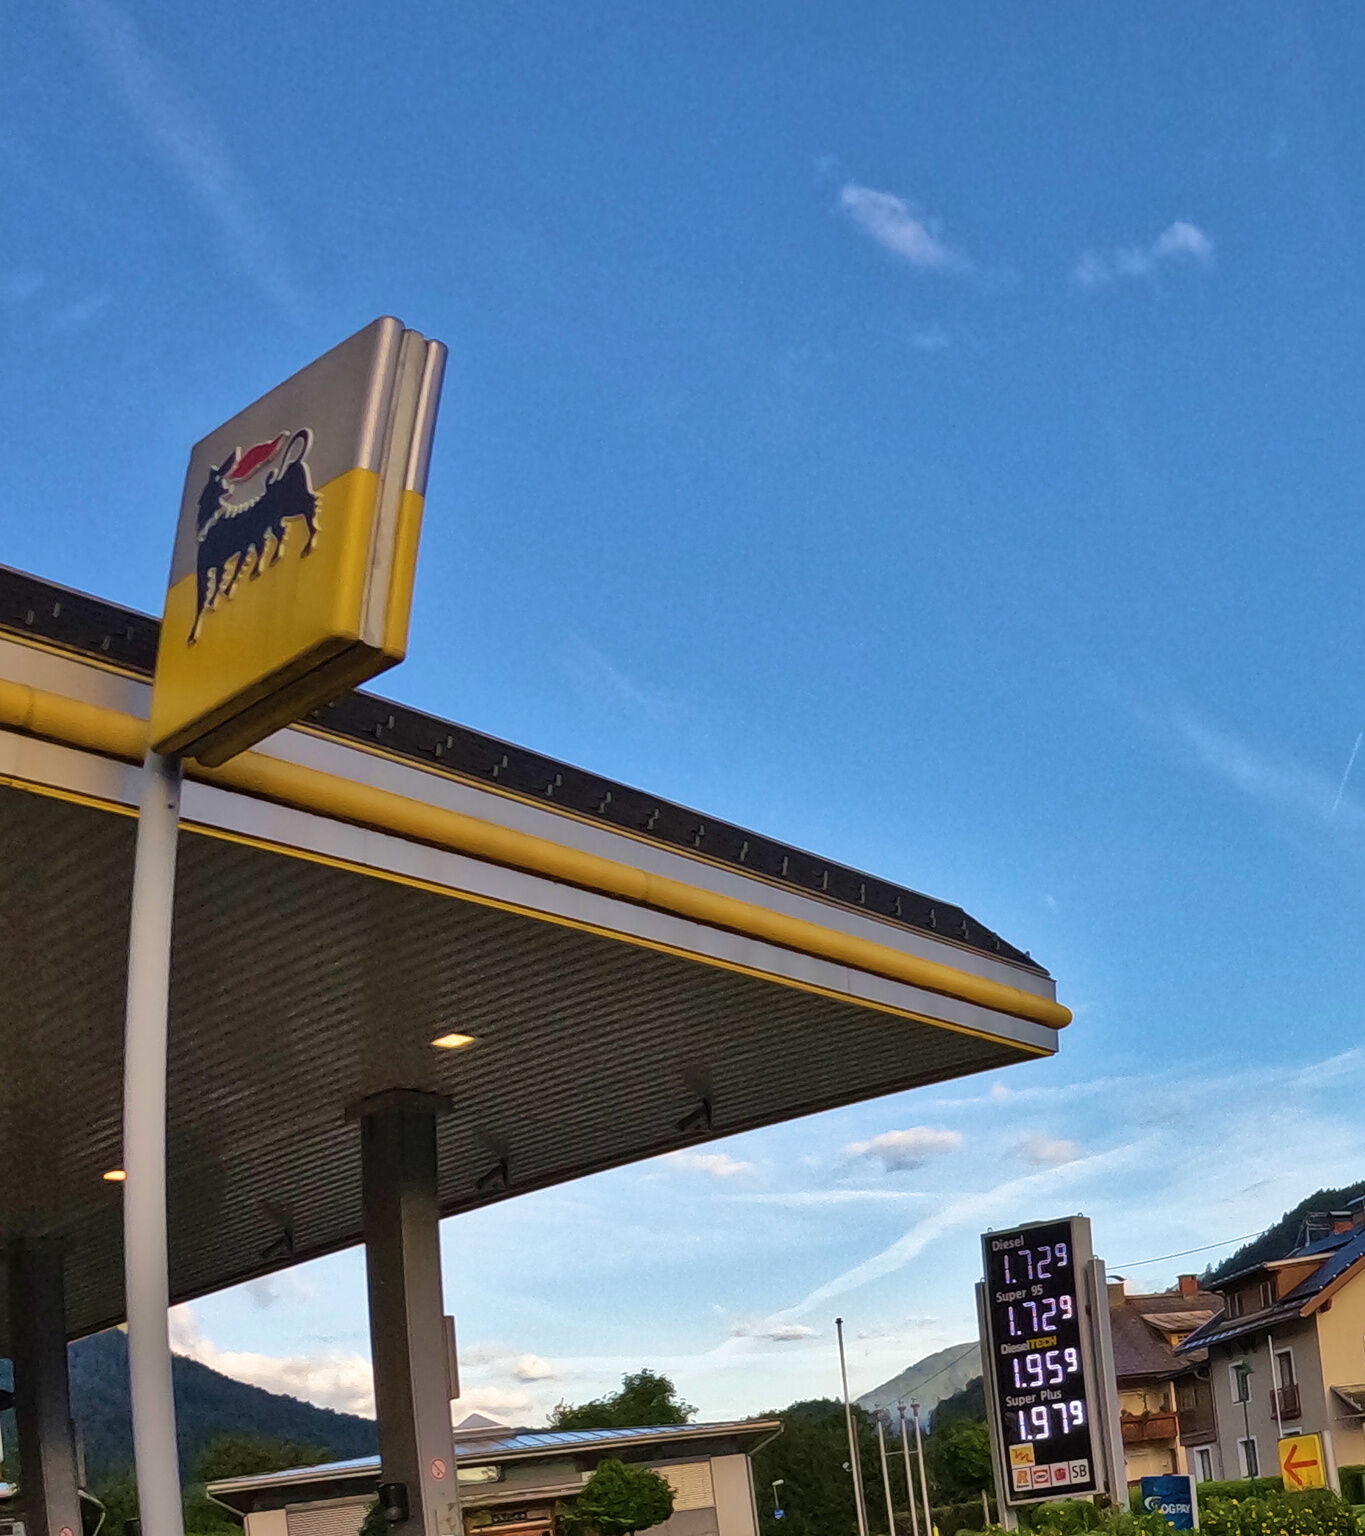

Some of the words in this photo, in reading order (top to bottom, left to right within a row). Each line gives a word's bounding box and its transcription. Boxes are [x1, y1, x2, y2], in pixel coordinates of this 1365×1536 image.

[992, 1234, 1024, 1252] Diesel
[1003, 1243, 1068, 1284] 1.729
[996, 1289, 1027, 1303] Super
[1031, 1284, 1044, 1296] 95
[1008, 1294, 1072, 1336] 1.729
[1012, 1347, 1078, 1388] 1.959
[1005, 1394, 1036, 1407] Super
[1041, 1389, 1062, 1401] Plus
[1018, 1400, 1084, 1440] 1.979
[1072, 1464, 1087, 1479] SB
[1156, 1503, 1190, 1515] OGPAY
